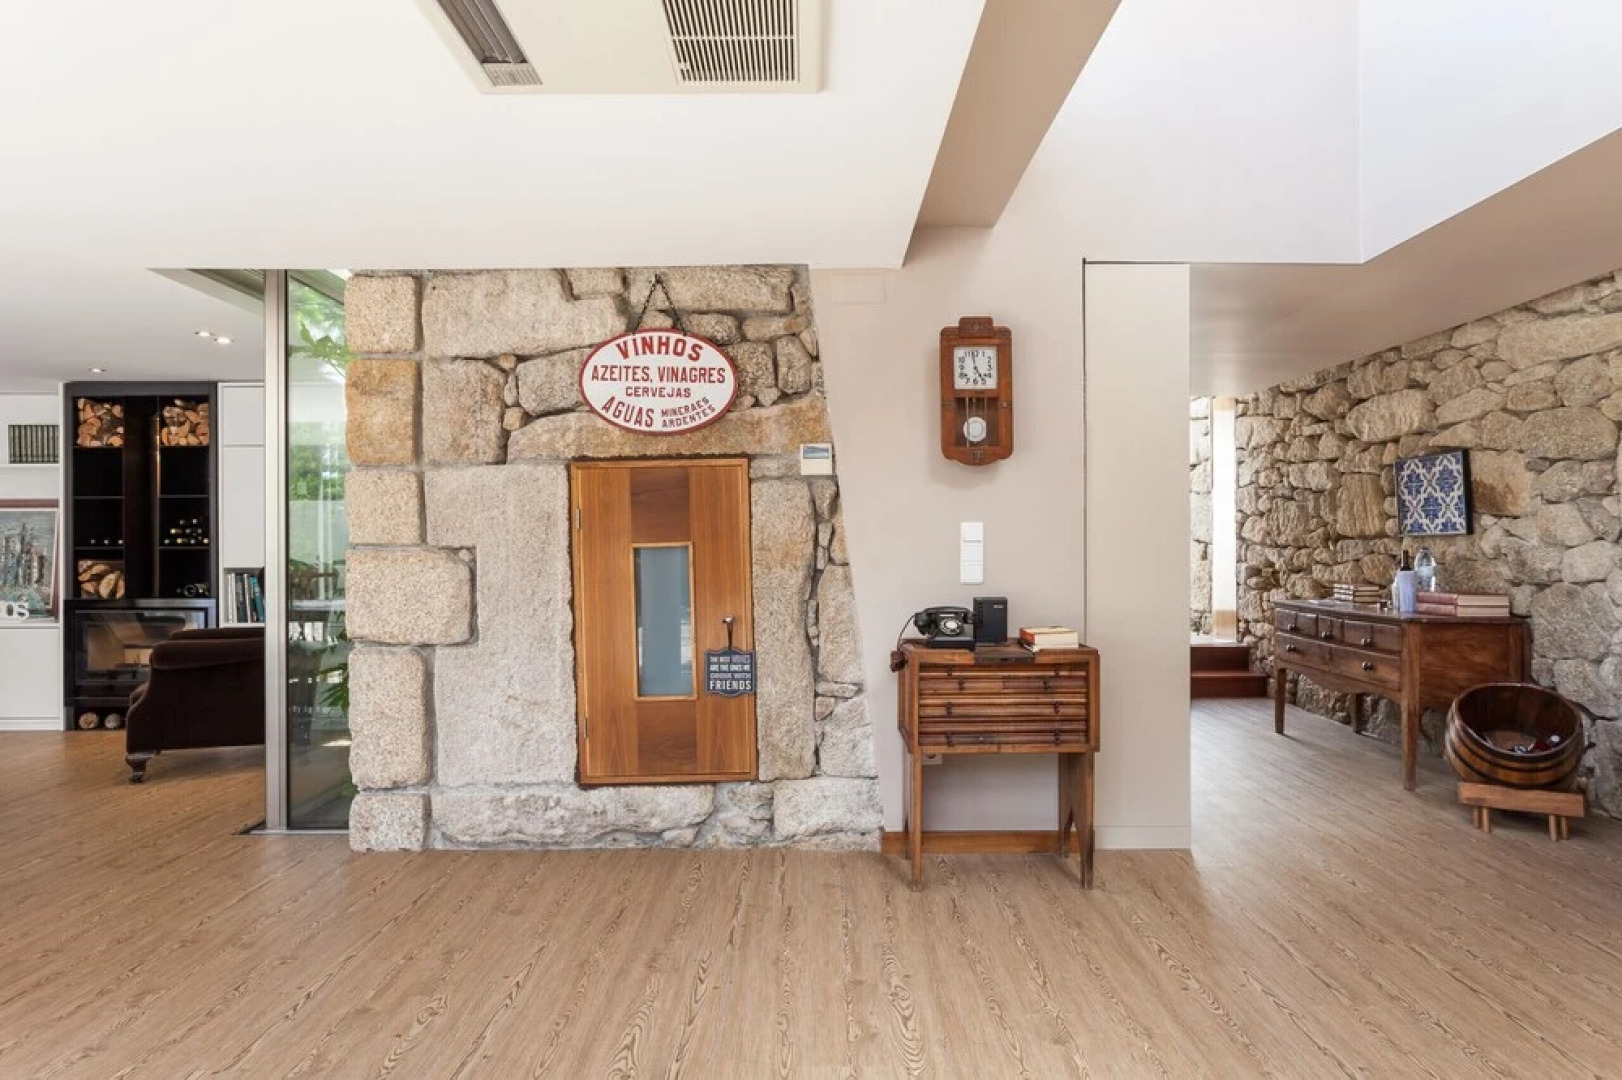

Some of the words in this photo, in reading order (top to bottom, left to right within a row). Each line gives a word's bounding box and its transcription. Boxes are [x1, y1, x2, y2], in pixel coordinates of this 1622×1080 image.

[616, 335, 703, 361] VINHOS
[591, 364, 653, 384] AZEITES,
[657, 366, 726, 384] VINAGRES
[625, 386, 692, 399] CERVEJAS
[601, 395, 655, 428] AGUAS
[661, 396, 710, 418] MINERAES
[661, 404, 716, 429] ARDENTES
[709, 680, 752, 690] FRIENDS
